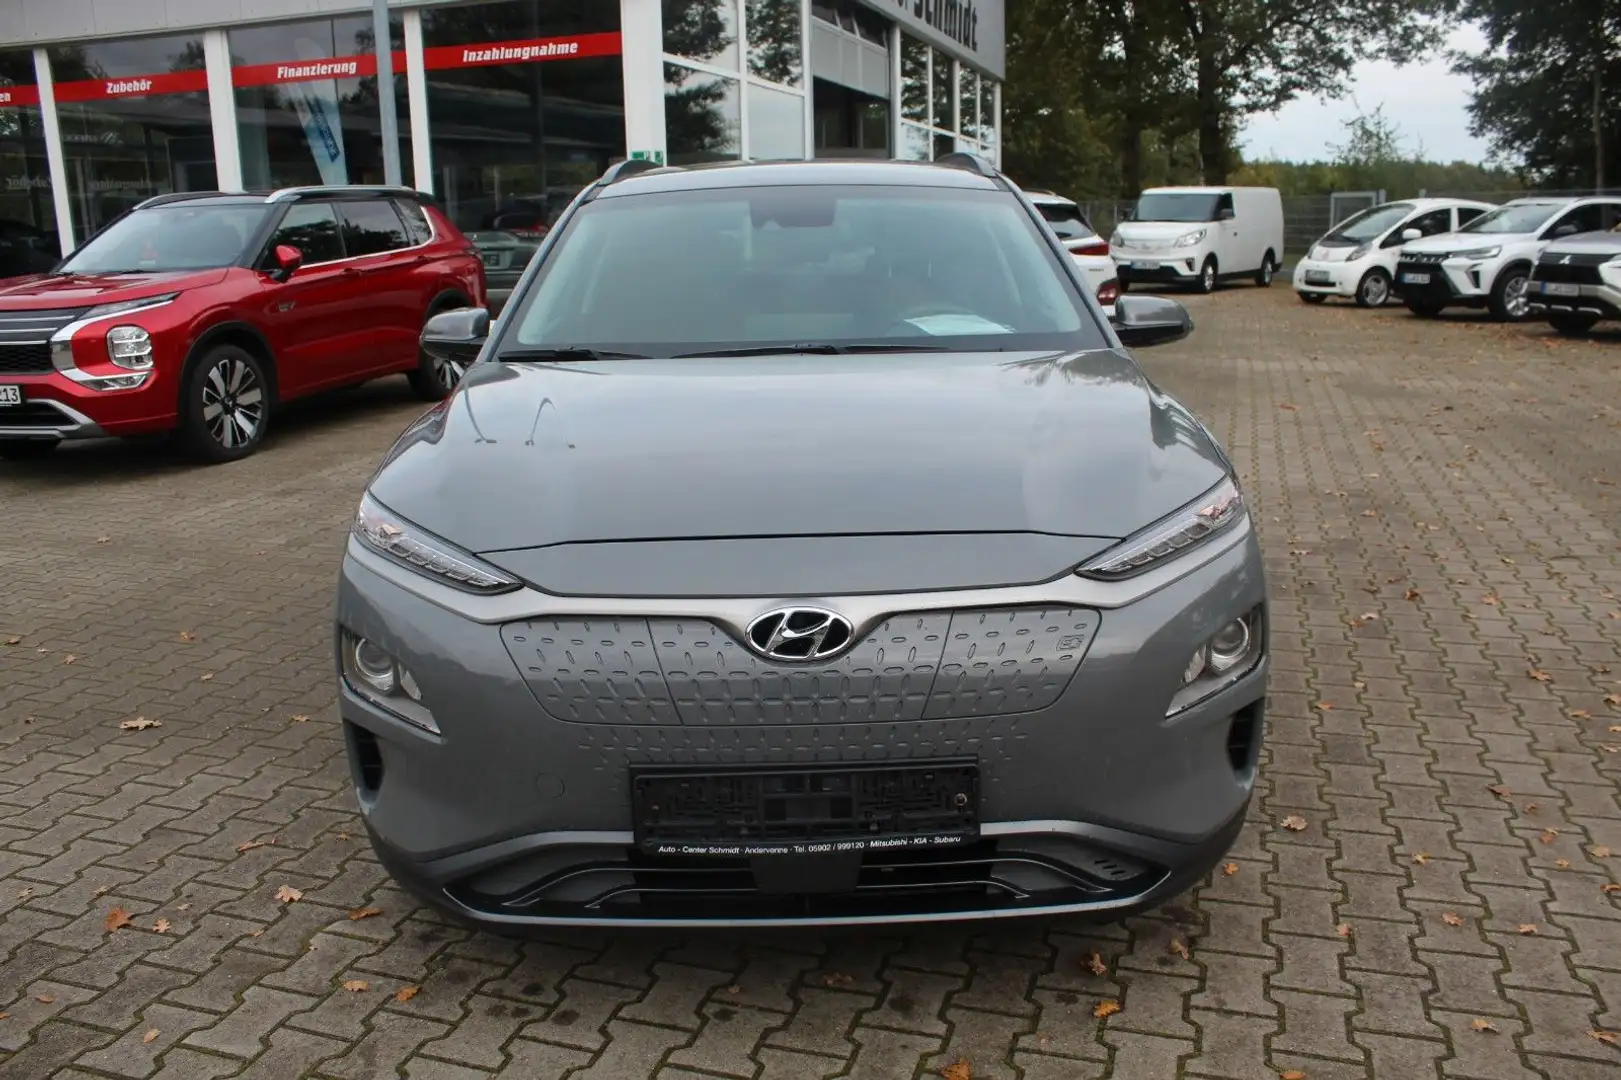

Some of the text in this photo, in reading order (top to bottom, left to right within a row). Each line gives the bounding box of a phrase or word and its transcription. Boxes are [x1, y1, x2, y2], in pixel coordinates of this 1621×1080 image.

[462, 41, 579, 63] Inzahlungnahme
[276, 60, 358, 79] Finanzierung
[105, 77, 153, 95] Zubehör
[658, 845, 676, 853] Auto
[682, 845, 707, 854] Center
[708, 846, 740, 854] Schmidt
[793, 845, 807, 853] Tel.
[808, 844, 832, 853] 05902
[837, 841, 865, 851] 999120
[869, 838, 908, 848] Mitsubishi
[913, 837, 927, 845] KIA
[934, 835, 961, 844] Subaru
